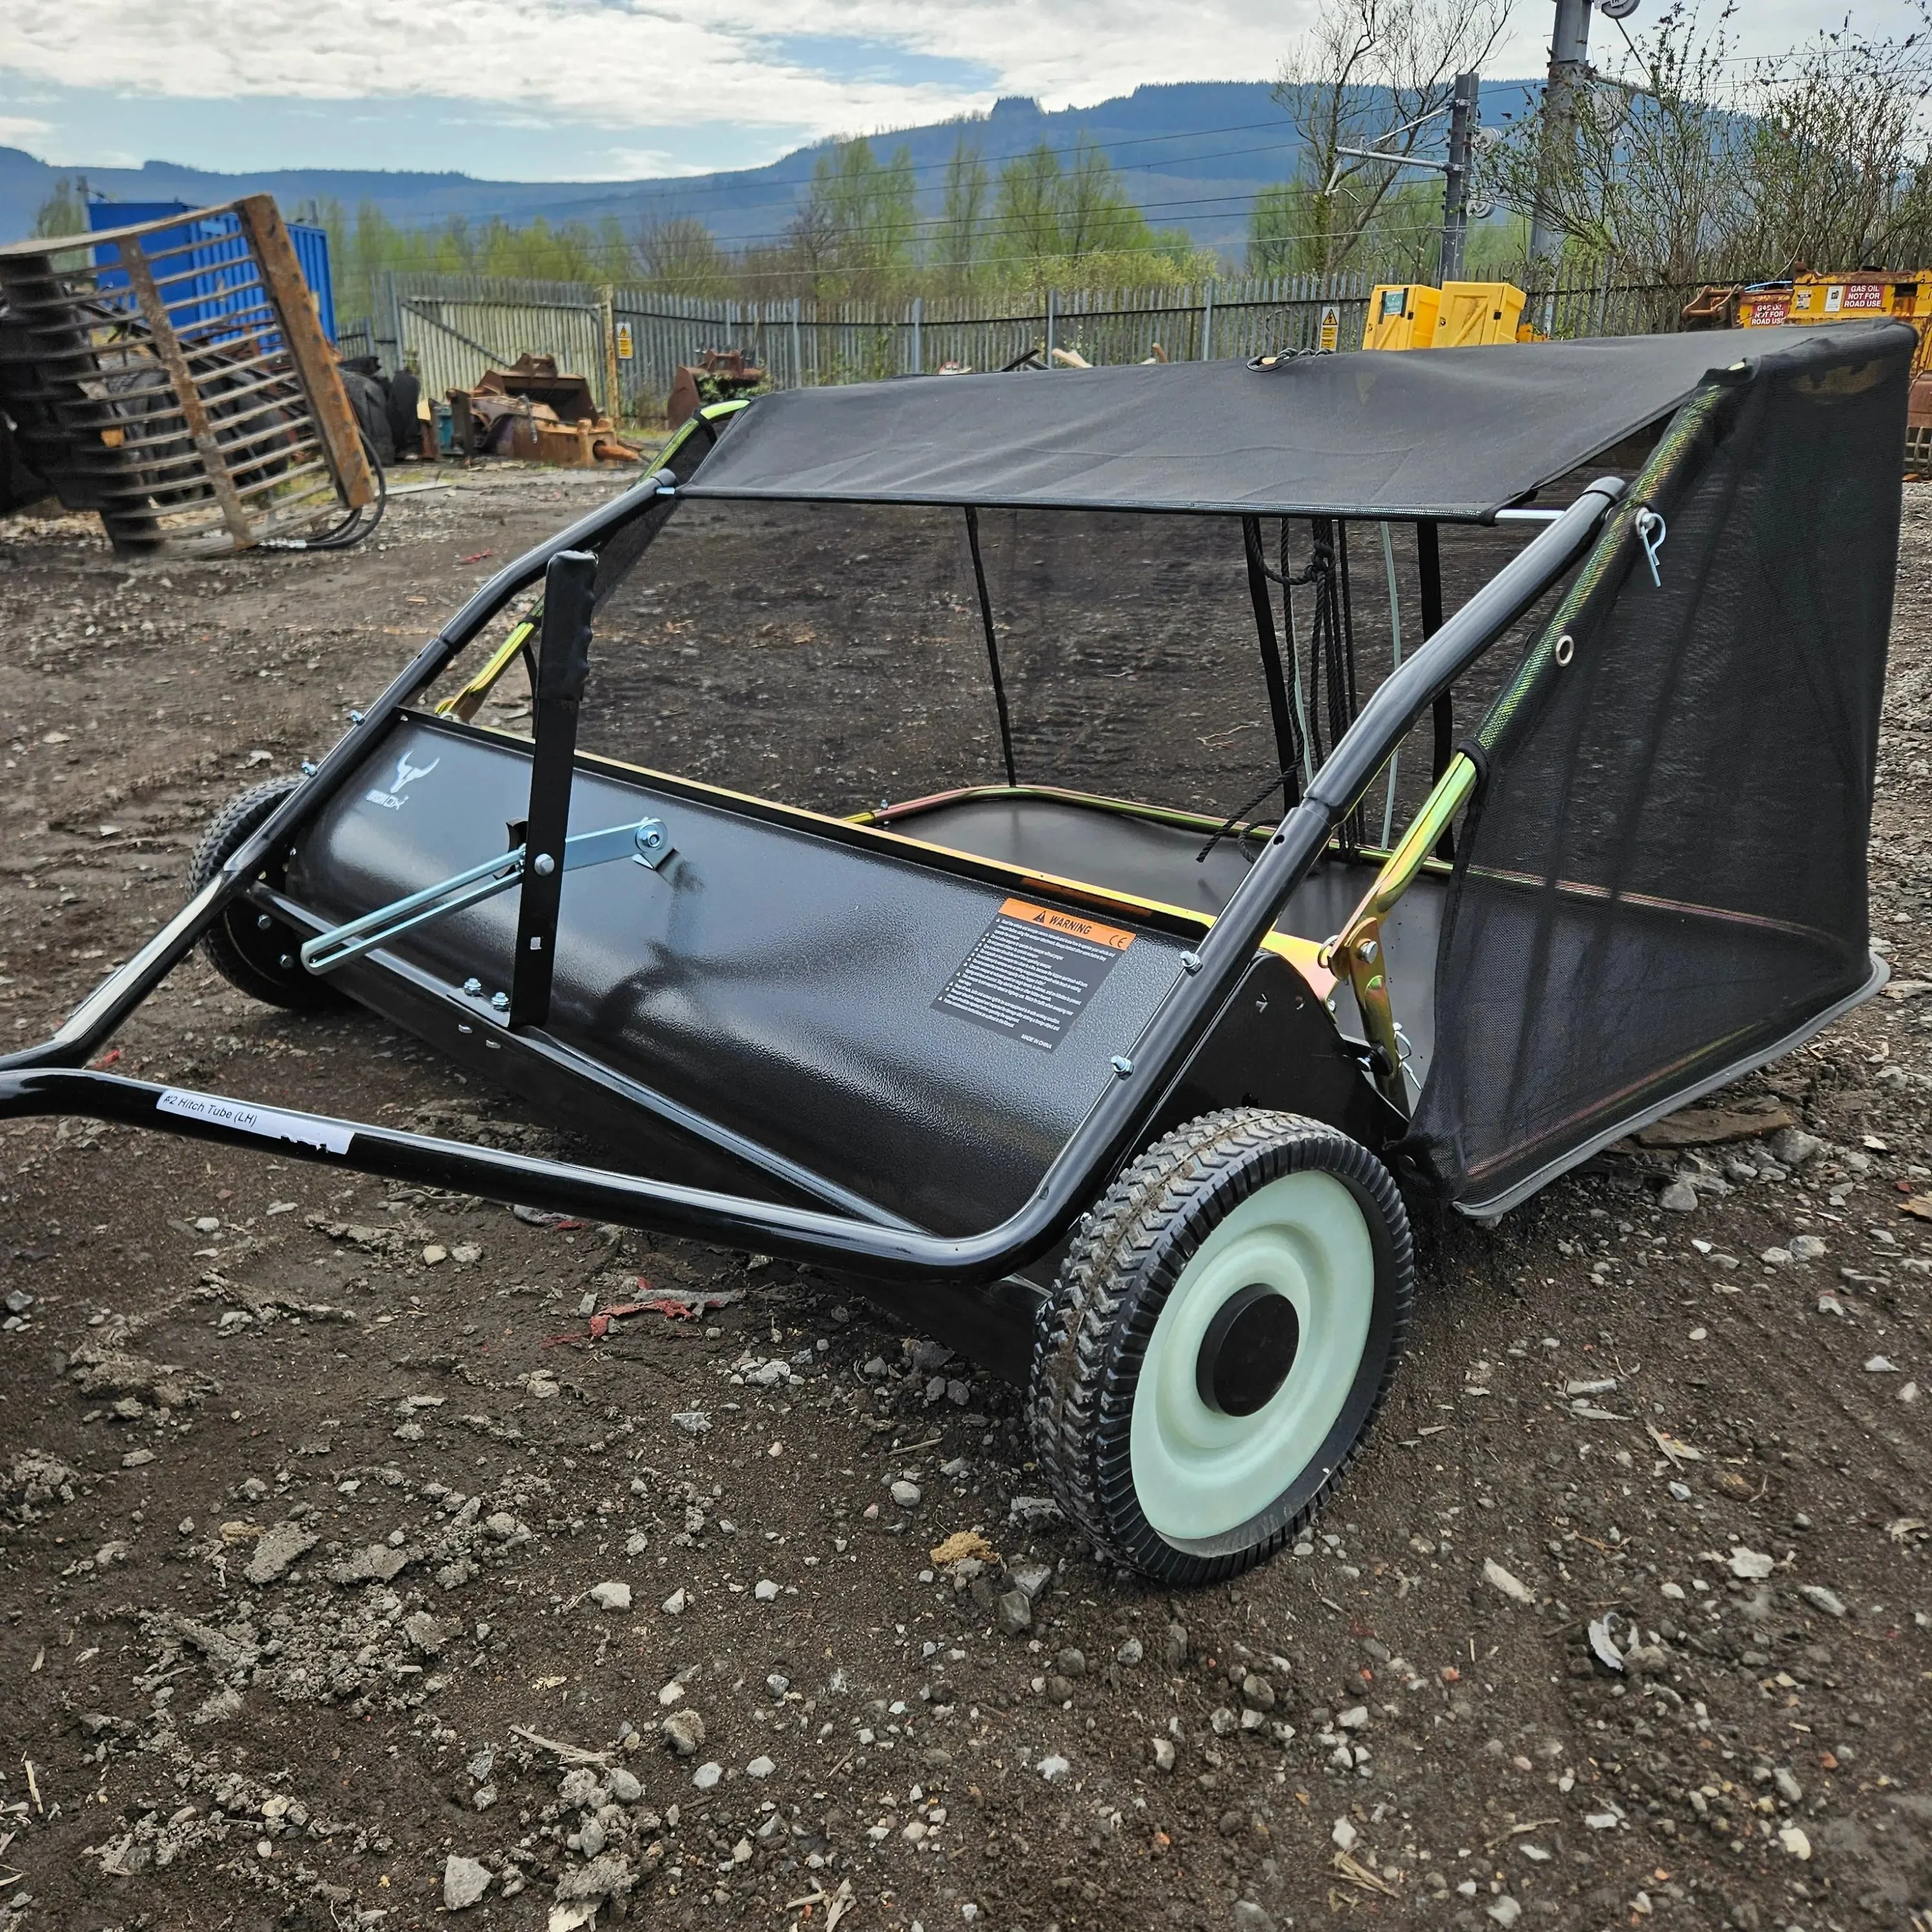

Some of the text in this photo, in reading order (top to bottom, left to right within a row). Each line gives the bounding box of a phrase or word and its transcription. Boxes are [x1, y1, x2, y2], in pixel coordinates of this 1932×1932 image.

[1049, 915, 1092, 934] WARNING
[1109, 934, 1127, 948] CE
[163, 1095, 258, 1127] #2 Hitch Tube (LH)
